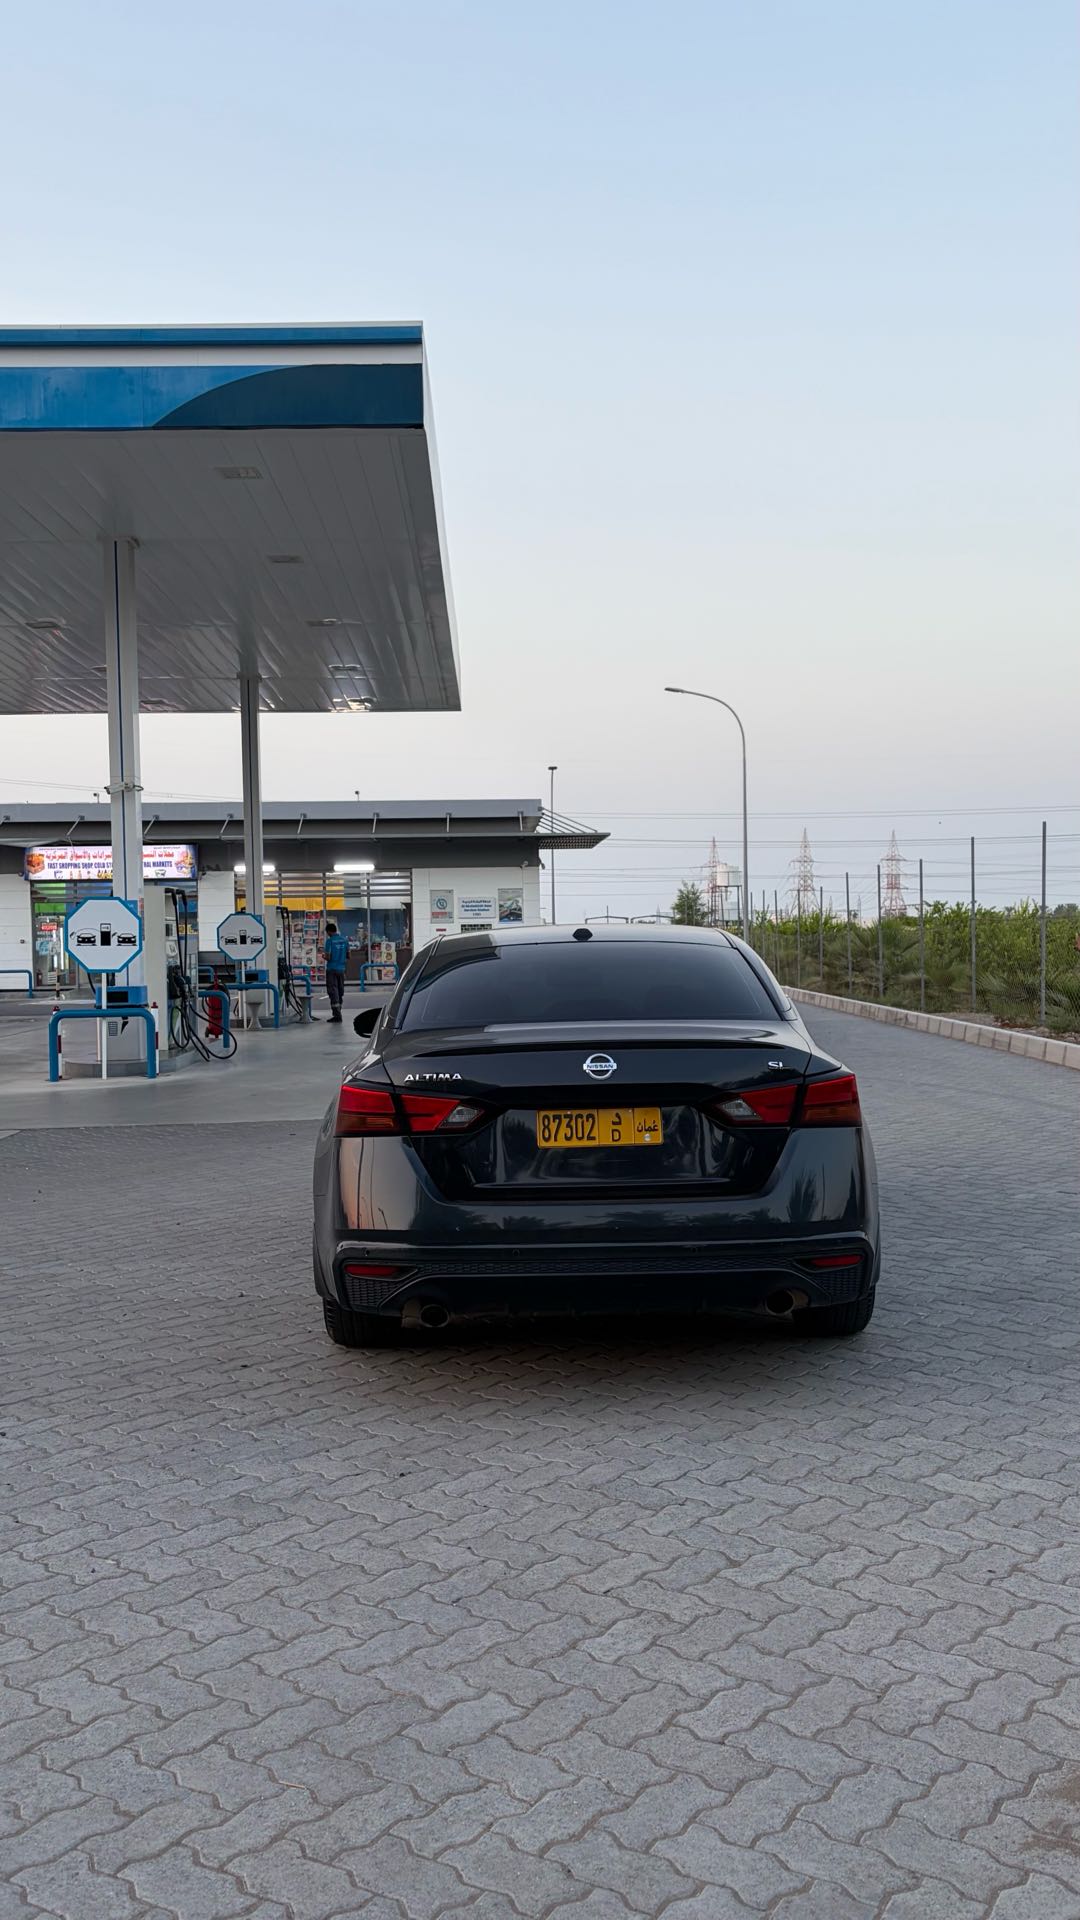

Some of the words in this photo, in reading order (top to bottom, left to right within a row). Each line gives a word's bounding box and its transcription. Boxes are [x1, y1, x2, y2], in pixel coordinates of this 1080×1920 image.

[94, 861, 105, 869] COLD
[404, 1072, 463, 1083] ALTIMA
[541, 1113, 597, 1143] 87302
[611, 1128, 622, 1142] D
